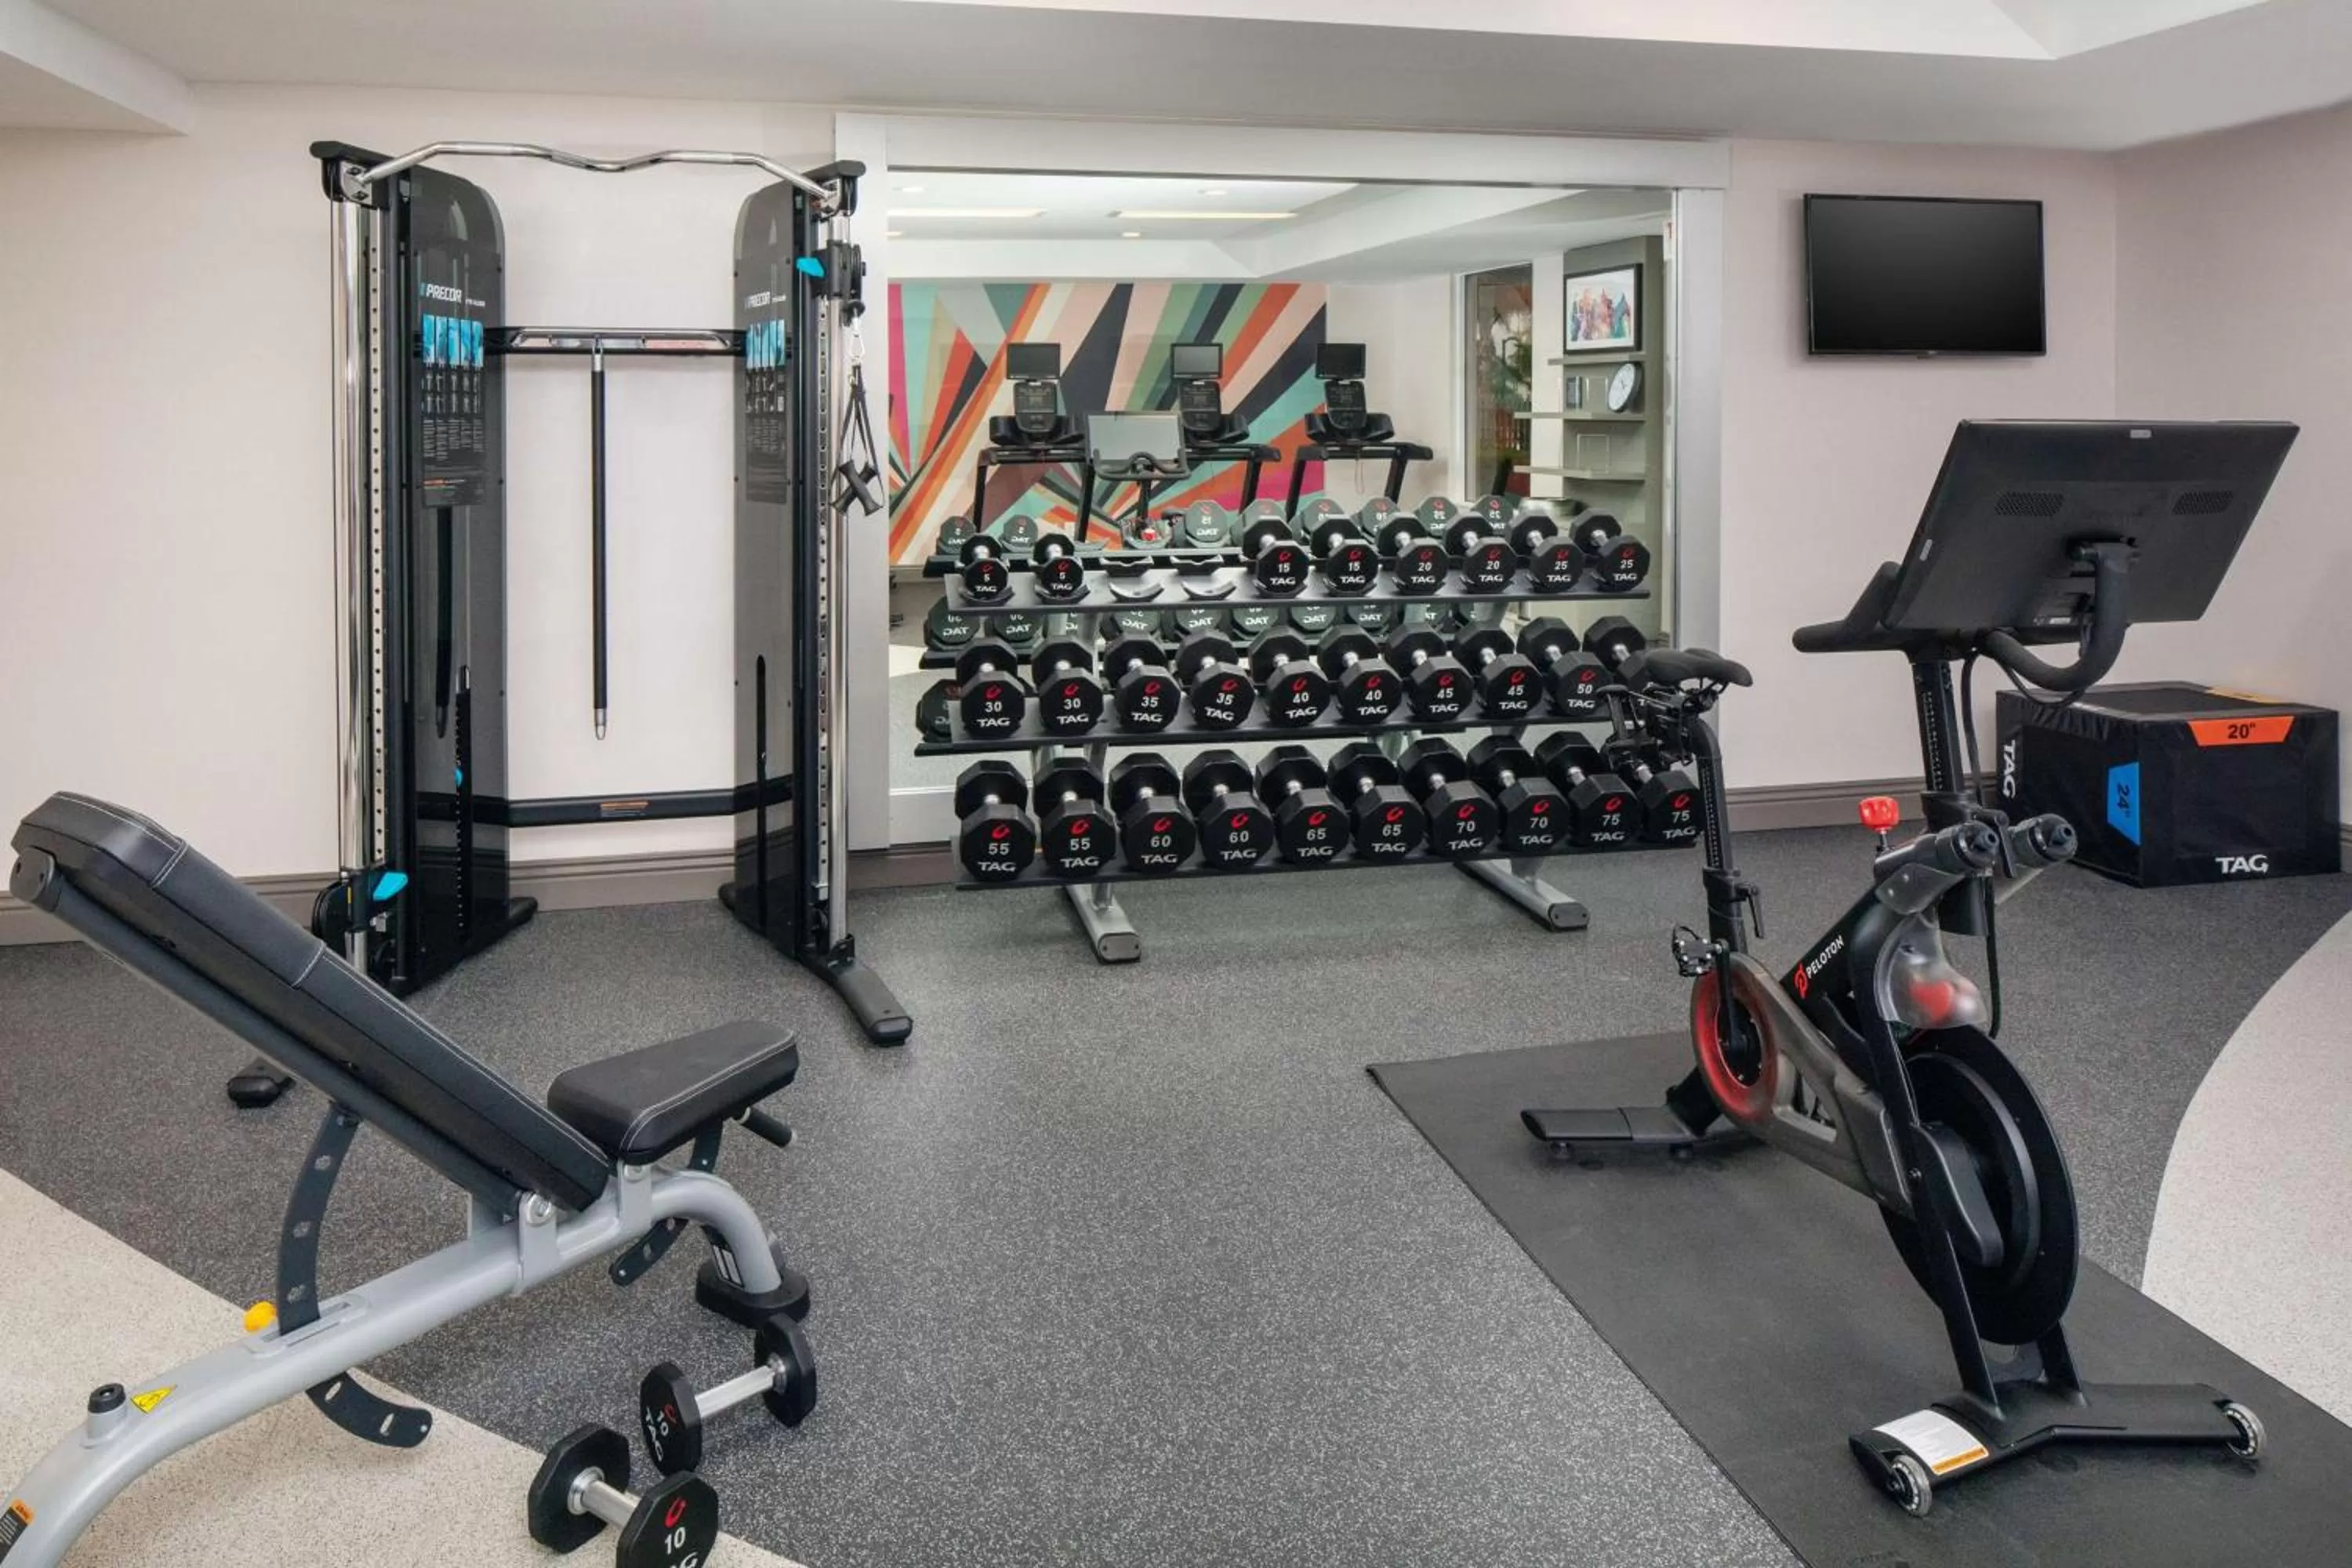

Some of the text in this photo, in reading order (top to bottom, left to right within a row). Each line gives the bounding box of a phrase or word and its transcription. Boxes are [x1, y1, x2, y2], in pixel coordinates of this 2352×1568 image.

[1277, 562, 1290, 573] 15
[1347, 561, 1361, 572] 15
[1417, 562, 1432, 572] 20
[1486, 561, 1501, 570] 20
[1554, 560, 1569, 571] 25
[1620, 559, 1635, 569] 25
[984, 573, 991, 583] 5
[1059, 571, 1066, 580] 5
[1269, 577, 1296, 586] TAG
[1339, 575, 1366, 584] TAG
[1410, 575, 1436, 584] TAG
[1478, 574, 1504, 583] TAG
[1546, 574, 1572, 583] TAG
[1613, 572, 1638, 582] TAG
[1050, 583, 1074, 591] TAG
[1436, 687, 1455, 699] 45
[1506, 684, 1524, 696] 45
[1577, 683, 1594, 695] 50
[1141, 696, 1159, 707] 35
[1216, 692, 1235, 705] 35
[1292, 692, 1310, 704] 40
[1365, 690, 1384, 702] 40
[985, 702, 1003, 713] 30
[1063, 698, 1082, 710] 30
[1429, 702, 1459, 713] TAG
[1498, 700, 1529, 710] TAG
[1567, 698, 1595, 710] TAG
[1204, 706, 1236, 721] TAG
[1285, 706, 1318, 719] TAG
[1357, 704, 1389, 717] TAG
[976, 717, 1011, 728] TAG
[1056, 713, 1089, 725] TAG
[1131, 711, 1163, 723] TAG
[2227, 723, 2256, 739] 20"
[2002, 739, 2016, 800] TAG
[1602, 815, 1621, 826] 75
[1672, 810, 1690, 822] 75
[1457, 821, 1476, 833] 70
[1530, 817, 1548, 829] 70
[1307, 828, 1327, 841] 65
[1382, 824, 1403, 837] 65
[1591, 831, 1625, 842] TAG
[1663, 826, 1696, 839] TAG
[1150, 836, 1171, 848] 60
[1229, 831, 1250, 844] 60
[1519, 835, 1553, 845] TAG
[989, 843, 1010, 856] 55
[1070, 838, 1091, 851] 55
[1372, 843, 1406, 853] TAG
[1449, 838, 1483, 850] TAG
[1220, 849, 1257, 861] TAG
[1297, 846, 1334, 858] TAG
[1060, 856, 1099, 868] TAG
[1141, 854, 1178, 865] TAG
[2216, 854, 2268, 874] TAG
[978, 862, 1017, 872] TAG
[1806, 935, 1845, 979] PELOTON
[657, 1410, 669, 1436] 10
[645, 1405, 664, 1461] TAG
[664, 1526, 686, 1555] 10
